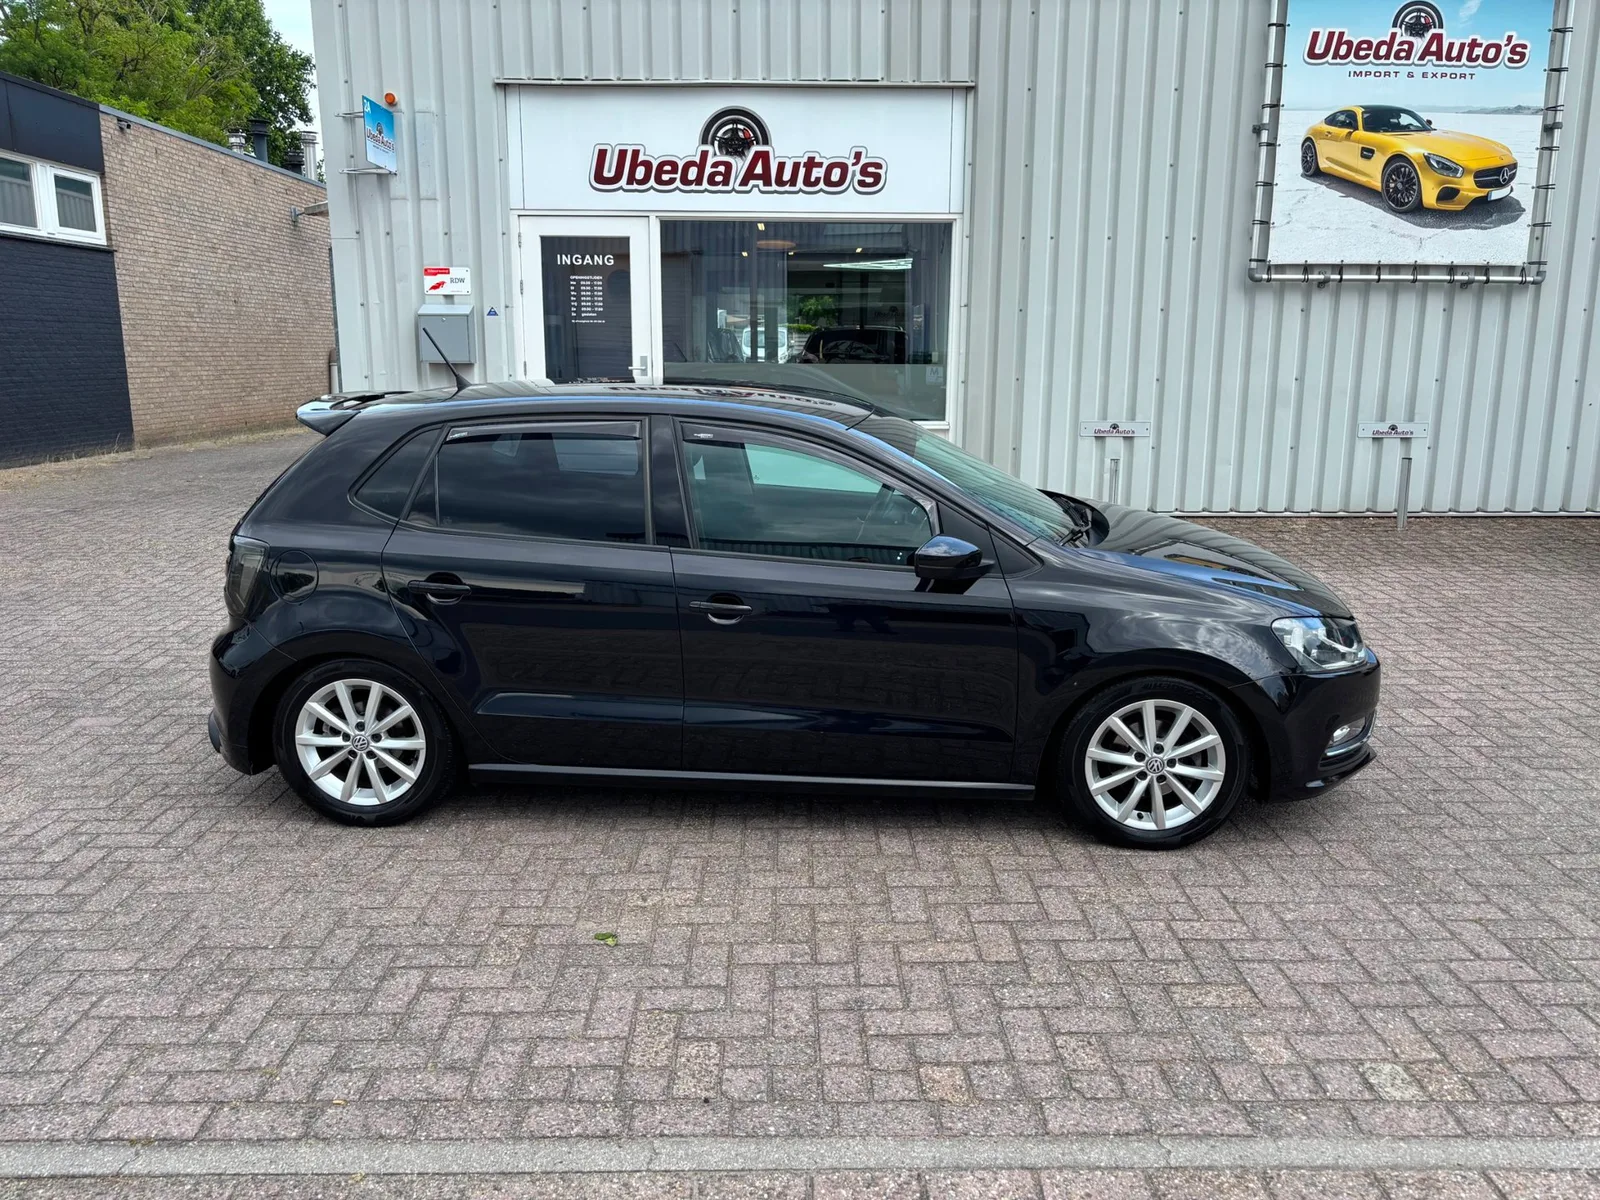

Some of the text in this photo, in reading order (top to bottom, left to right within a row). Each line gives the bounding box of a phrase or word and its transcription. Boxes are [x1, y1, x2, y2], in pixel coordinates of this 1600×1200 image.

[1307, 31, 1528, 64] Ubeda Auto's
[1348, 70, 1476, 80] IMPORT & EXPORT
[366, 127, 381, 144] Ubeda
[593, 148, 882, 188] Ubeda Auto's
[556, 254, 615, 266] INGANG
